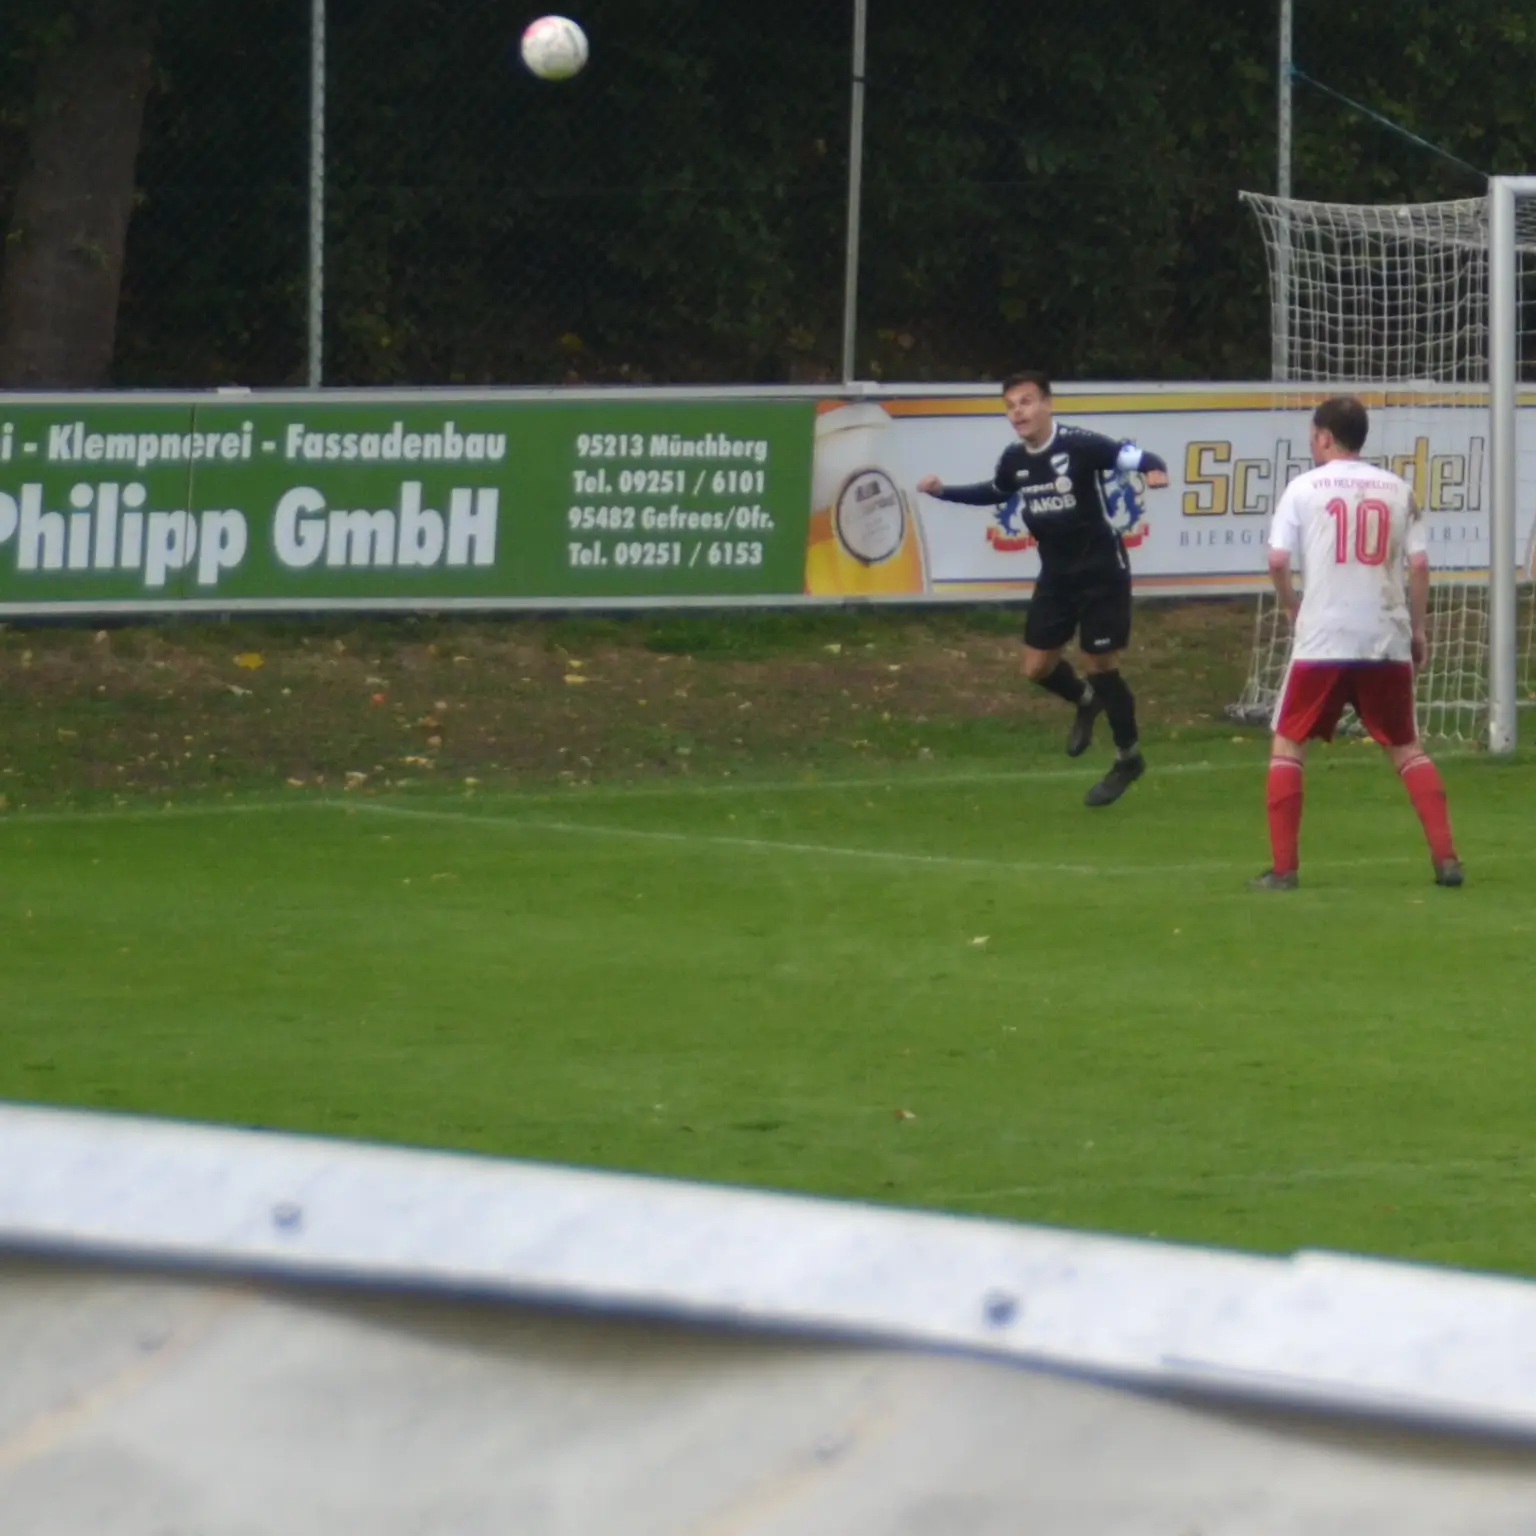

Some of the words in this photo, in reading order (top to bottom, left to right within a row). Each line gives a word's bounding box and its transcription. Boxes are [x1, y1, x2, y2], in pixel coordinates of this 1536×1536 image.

[48, 419, 254, 467] Klempnerei
[285, 420, 507, 460] Fassadenbau
[575, 432, 645, 458] 95213
[649, 432, 769, 462] Münchberg
[571, 467, 613, 494] Tel.
[617, 469, 687, 494] 09251
[711, 469, 765, 494] 6101
[1181, 435, 1486, 517] Schdel
[273, 480, 500, 568] GmbH
[567, 504, 637, 530] 95482
[1326, 497, 1392, 567] 10
[567, 539, 608, 566] Tel.
[613, 541, 682, 566] 09251
[706, 541, 764, 566] 6153
